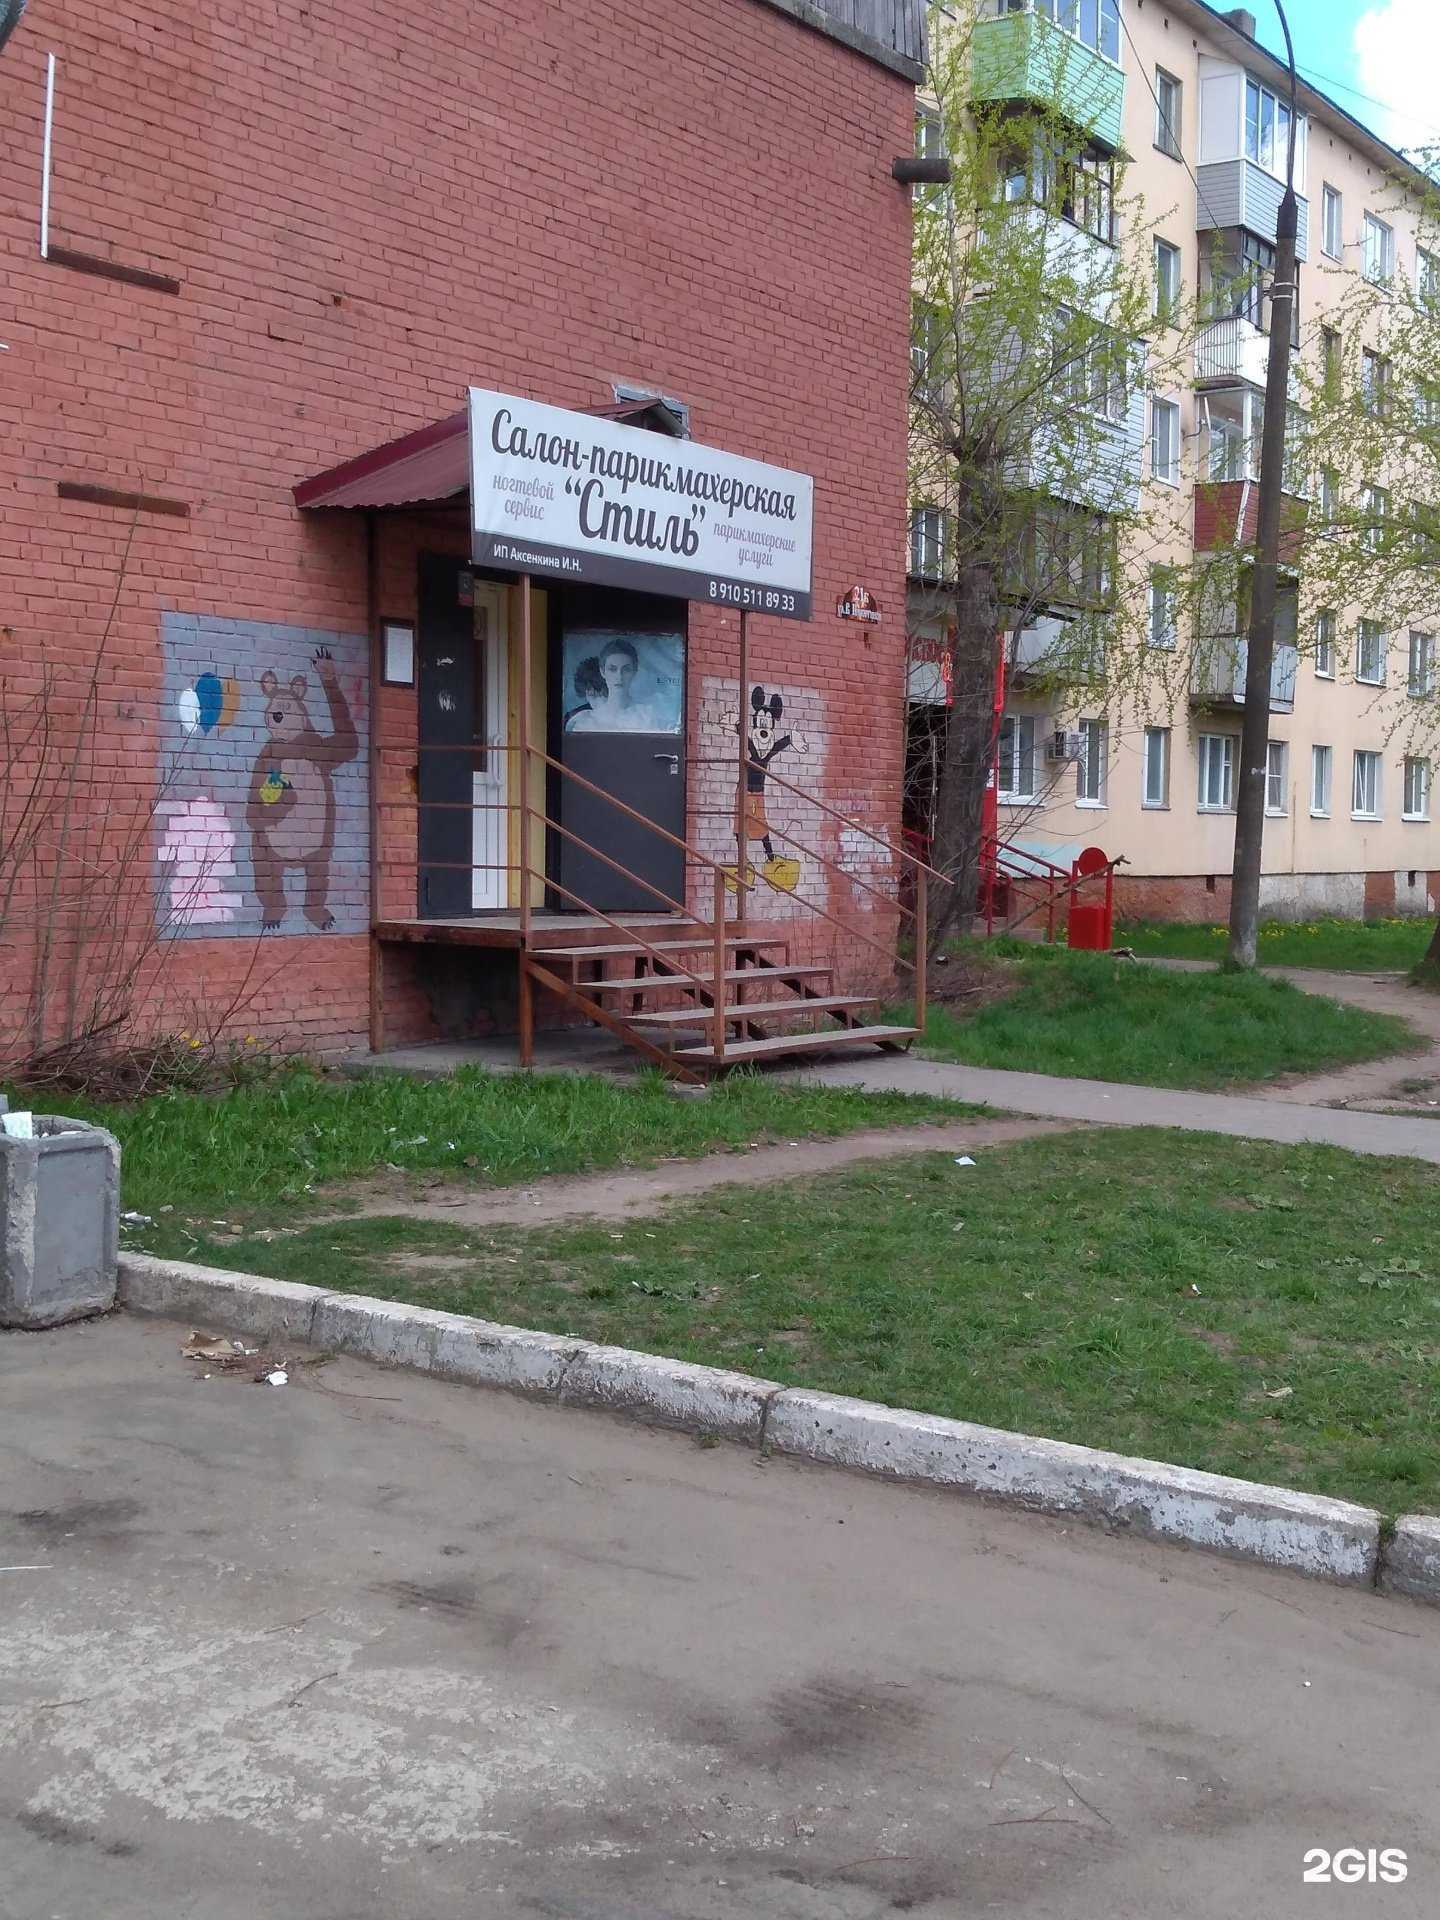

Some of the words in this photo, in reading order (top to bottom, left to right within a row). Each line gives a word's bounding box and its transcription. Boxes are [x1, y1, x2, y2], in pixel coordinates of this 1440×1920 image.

[491, 408, 797, 521] Салон-парикмахерская
[493, 474, 555, 501] ногтевой
[504, 498, 545, 521] сервис
[713, 522, 796, 552] парикмахерские
[493, 543, 509, 559] ИП
[510, 547, 560, 569] Аксенкина
[562, 556, 582, 572] И.Н.
[738, 547, 774, 569] услуги
[709, 581, 717, 598] 8
[719, 583, 741, 602] 910
[743, 587, 762, 606] 511
[766, 592, 780, 608] 89
[781, 594, 795, 611] 33
